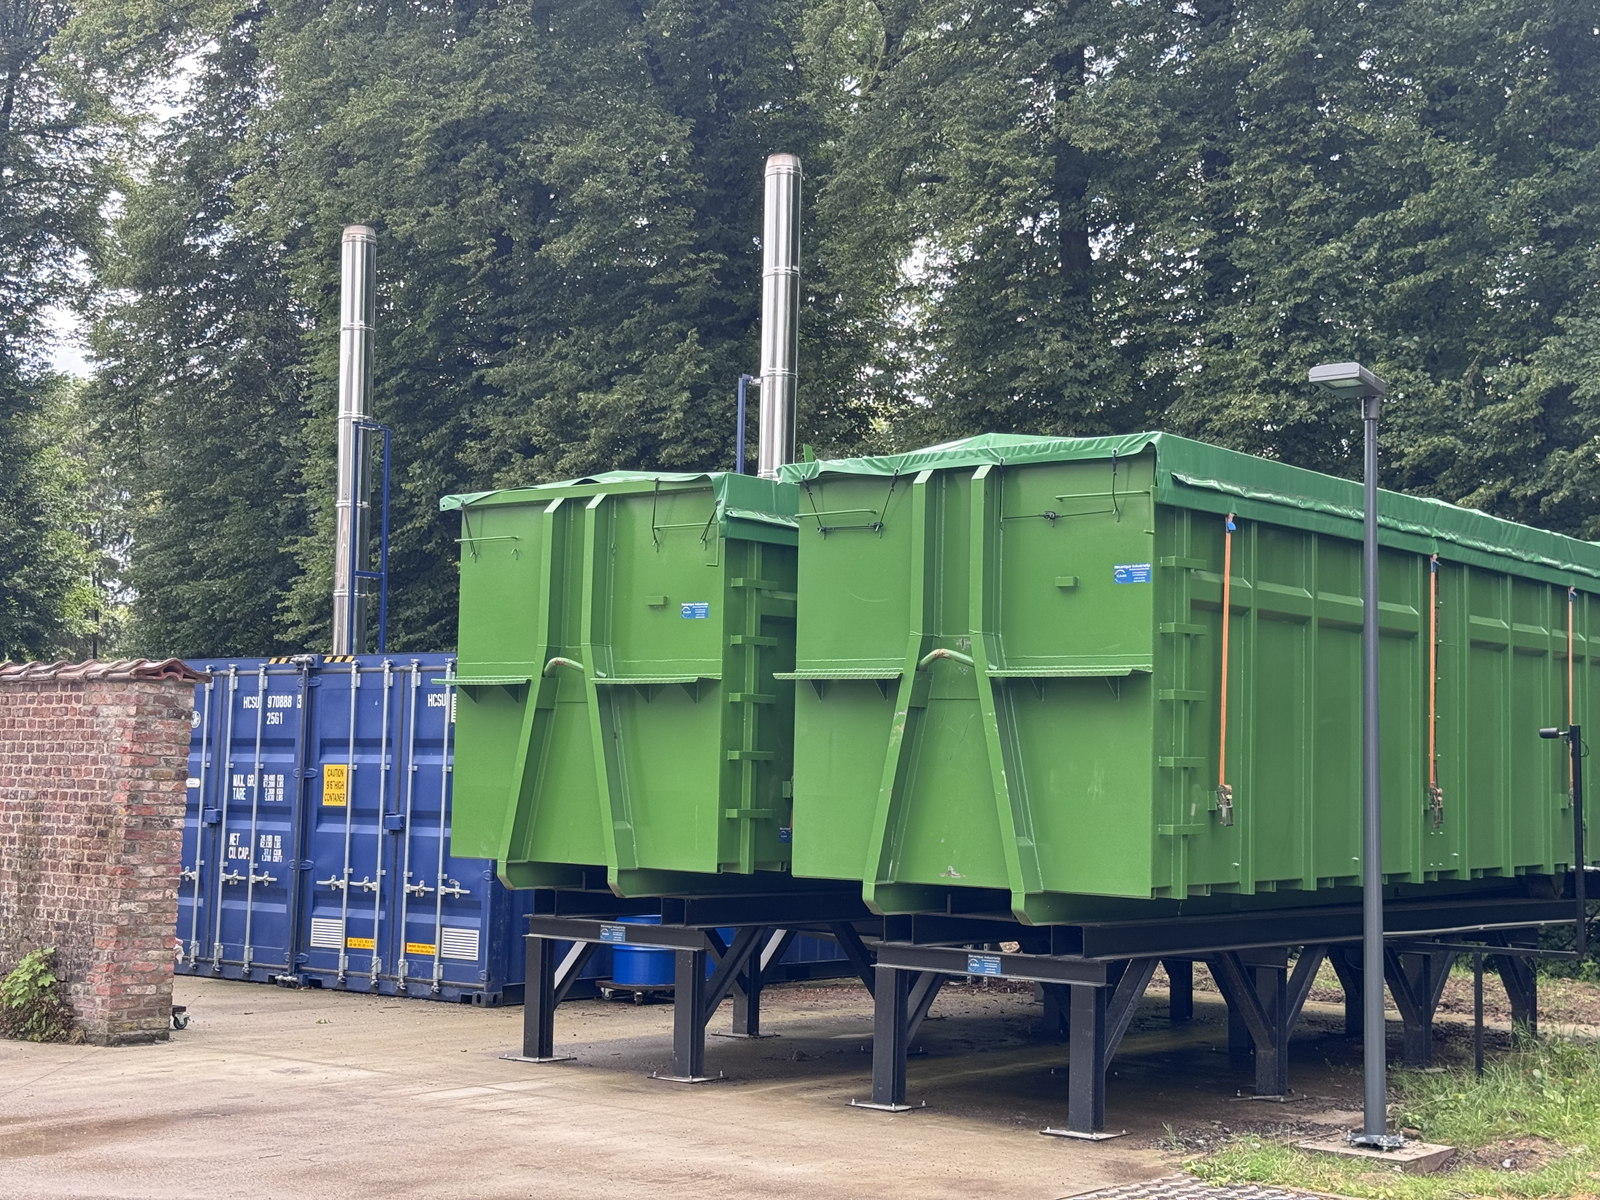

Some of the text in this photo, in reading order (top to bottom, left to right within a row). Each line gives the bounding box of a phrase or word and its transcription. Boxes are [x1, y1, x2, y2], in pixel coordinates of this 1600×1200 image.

[243, 696, 260, 709] HCSU
[267, 695, 292, 708] 970888
[428, 694, 447, 707] HCSU
[266, 712, 283, 724] 25G1
[327, 769, 344, 777] CAUTION
[233, 774, 245, 787] MAX.
[233, 787, 246, 800] TARE
[324, 793, 345, 802] CONTAINER
[229, 833, 240, 845] NET
[238, 846, 250, 860] CAP.
